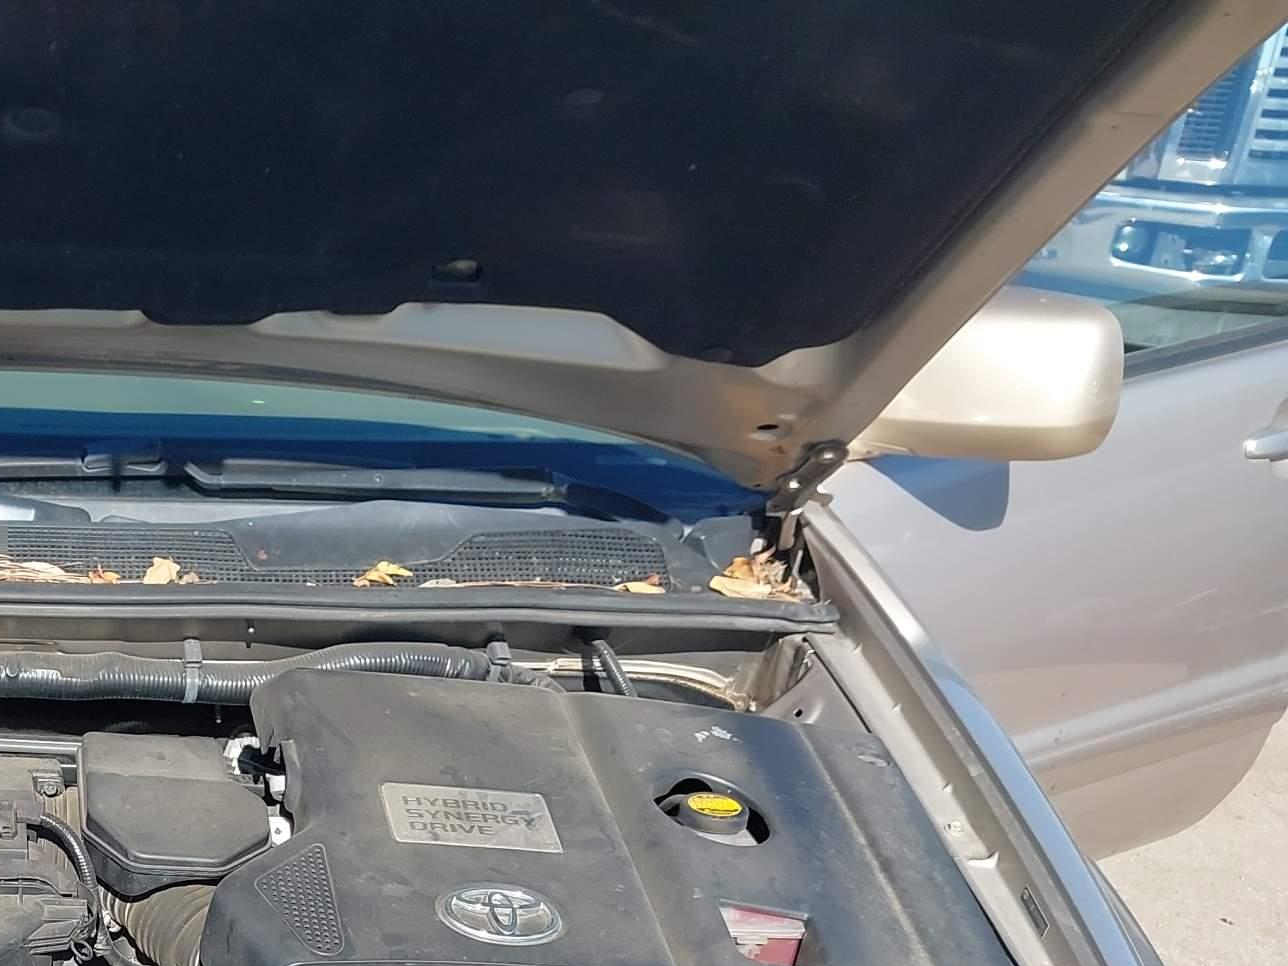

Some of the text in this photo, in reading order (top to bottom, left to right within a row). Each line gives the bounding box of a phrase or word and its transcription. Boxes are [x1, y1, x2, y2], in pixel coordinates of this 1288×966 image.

[401, 796, 508, 812] HYBRID
[406, 809, 537, 826] SYNERGY
[409, 821, 498, 835] DRIVE
